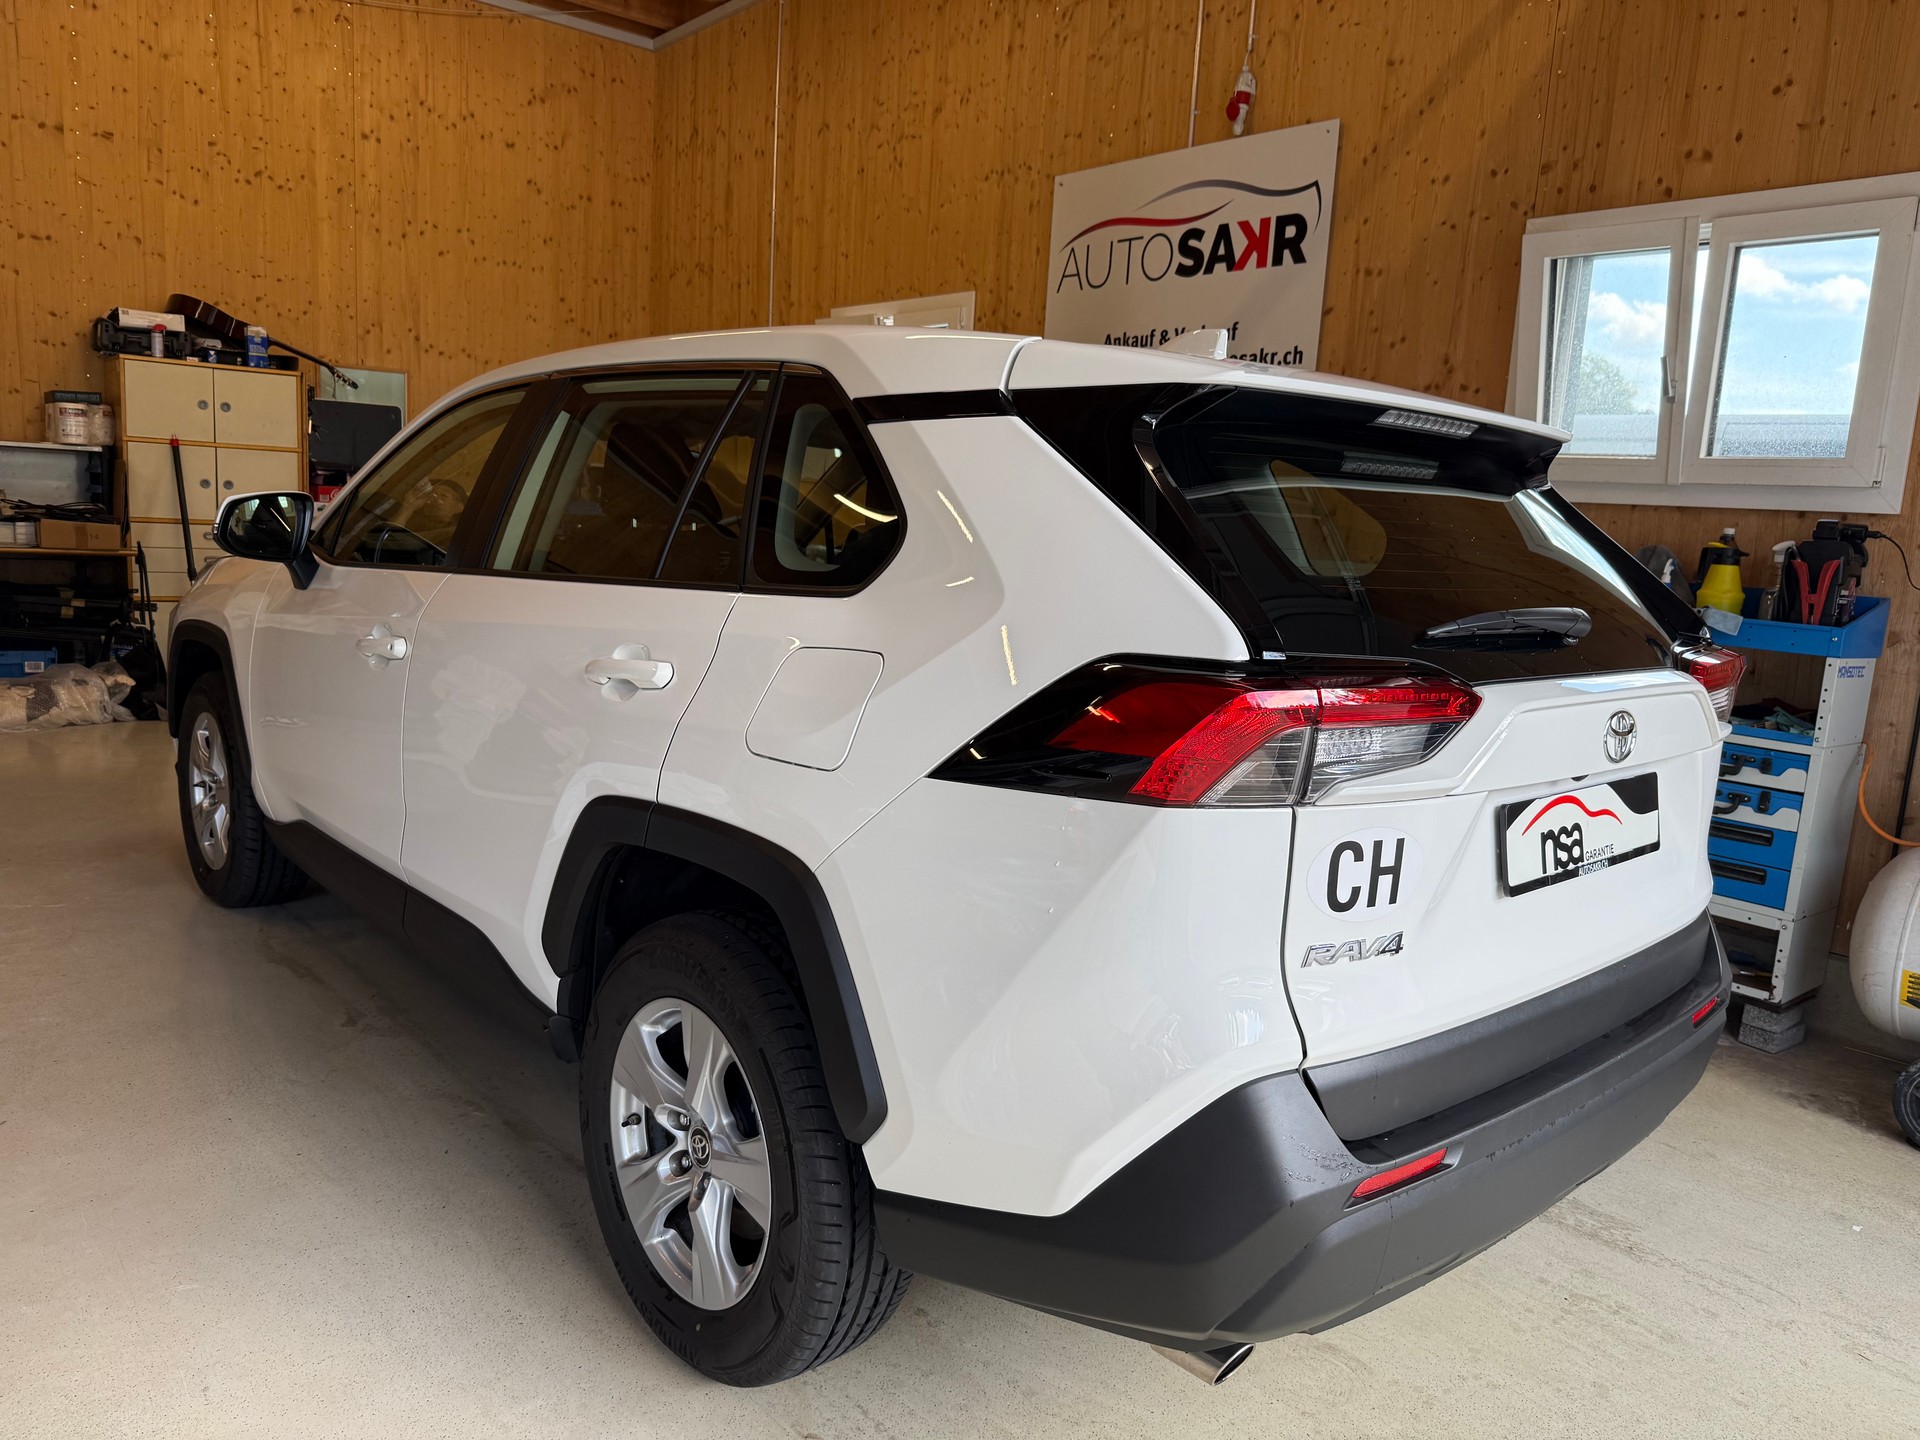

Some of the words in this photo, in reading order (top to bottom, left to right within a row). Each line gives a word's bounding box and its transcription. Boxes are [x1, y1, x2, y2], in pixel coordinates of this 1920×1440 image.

[1056, 213, 1308, 293] AUTOSAKR
[1104, 328, 1156, 348] Ankauf
[1159, 329, 1170, 345] &
[1541, 822, 1584, 875] nsa
[1585, 843, 1614, 862] GARANTIE
[1327, 838, 1405, 913] CH
[1301, 931, 1404, 968] RAV4
